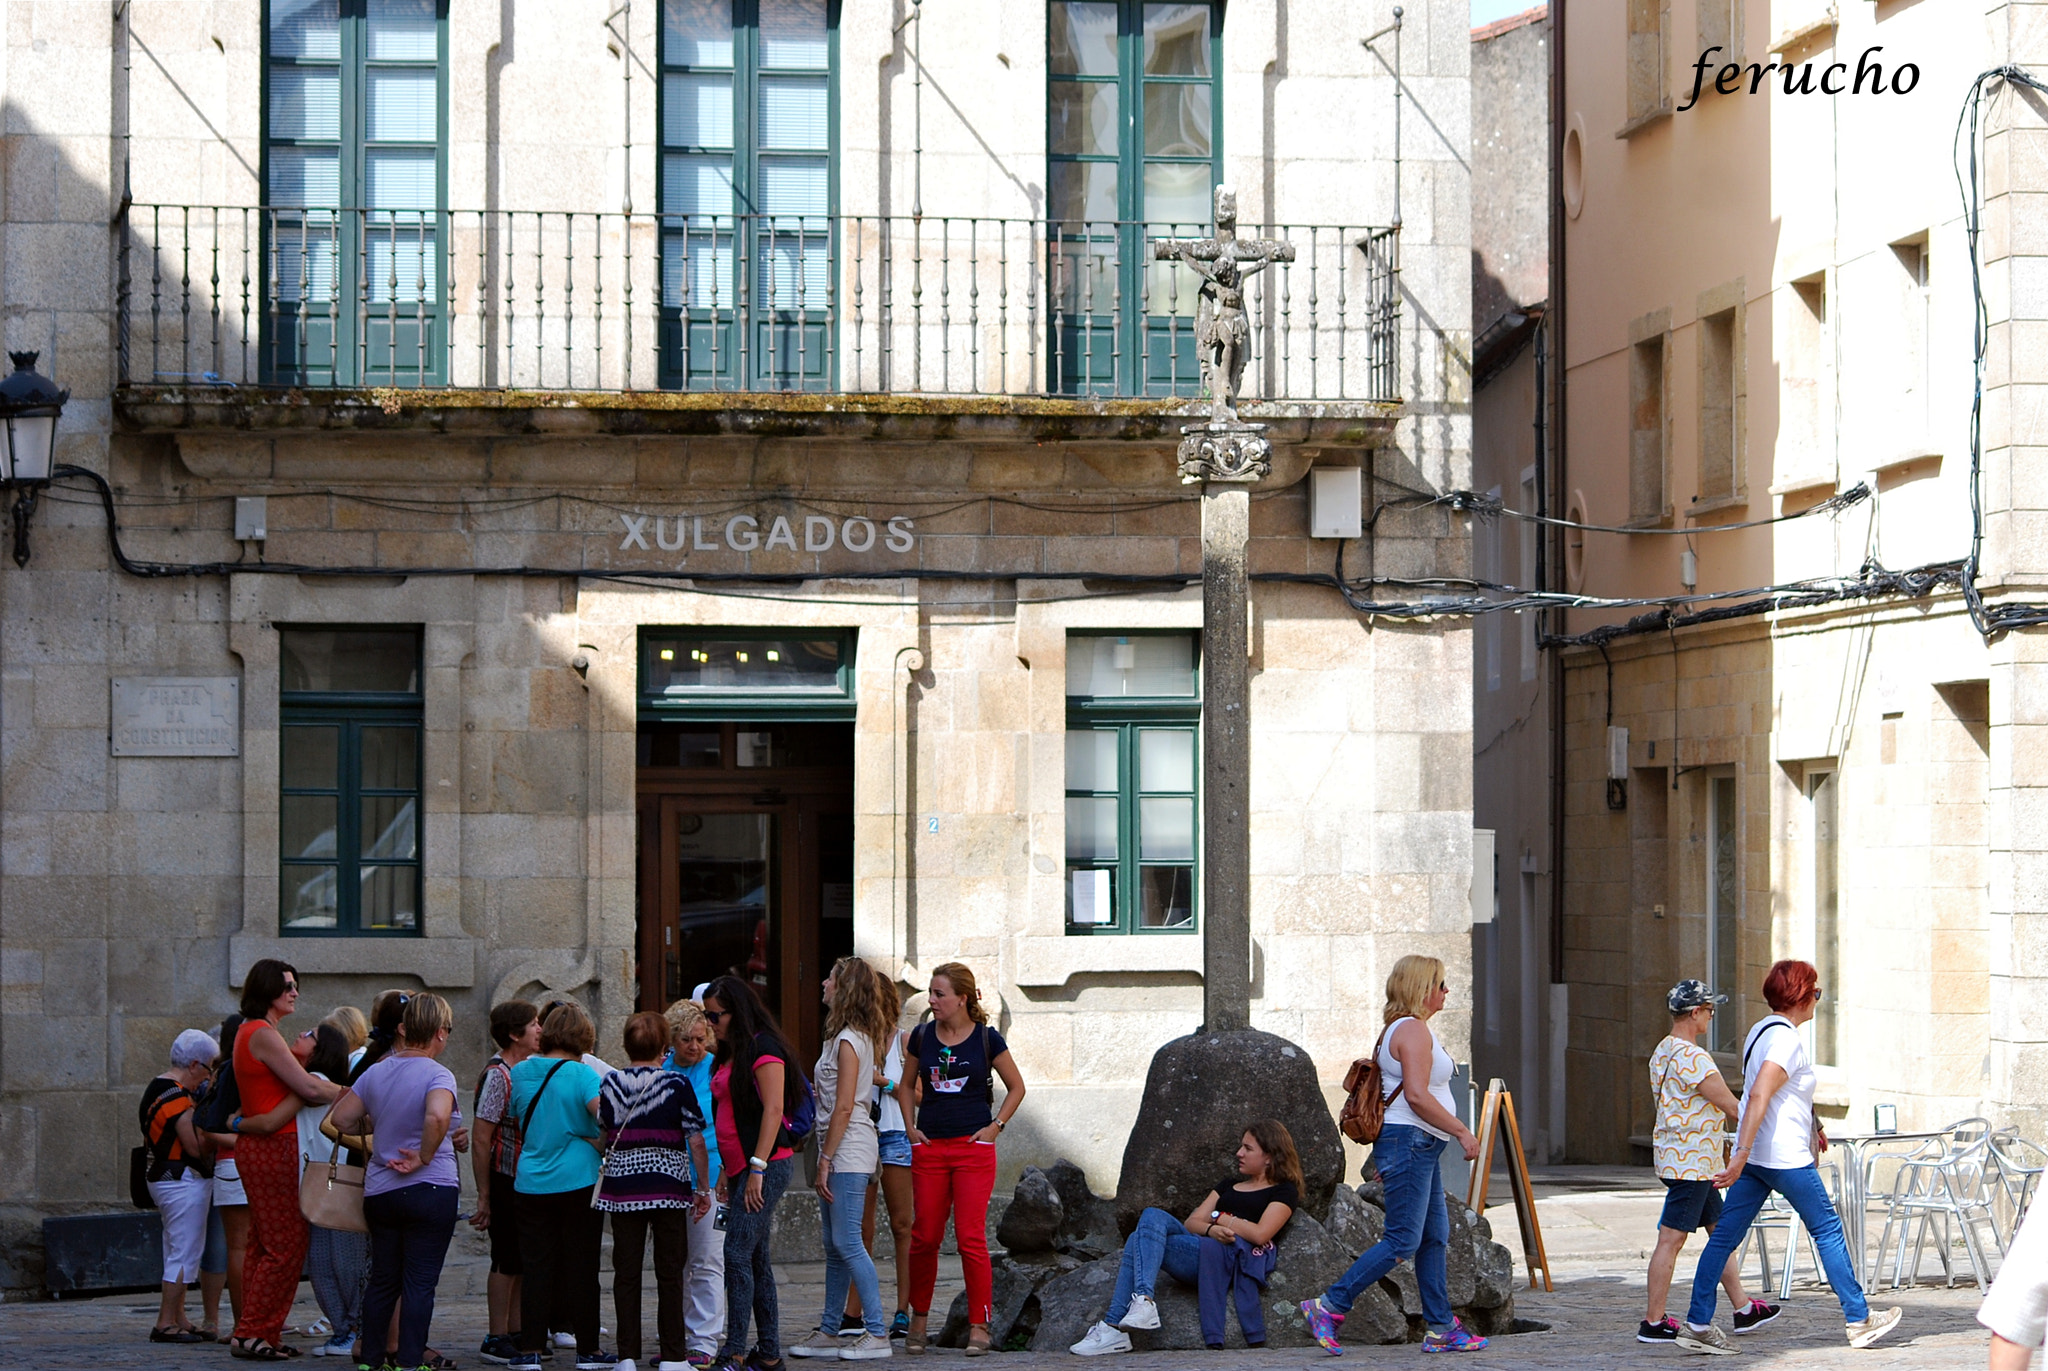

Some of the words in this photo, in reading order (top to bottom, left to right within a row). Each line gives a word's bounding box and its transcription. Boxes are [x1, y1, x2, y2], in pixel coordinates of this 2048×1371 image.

[618, 514, 915, 552] XULGADOS
[149, 688, 202, 706] PRAZA
[166, 709, 186, 724] DA
[929, 818, 938, 832] 2
